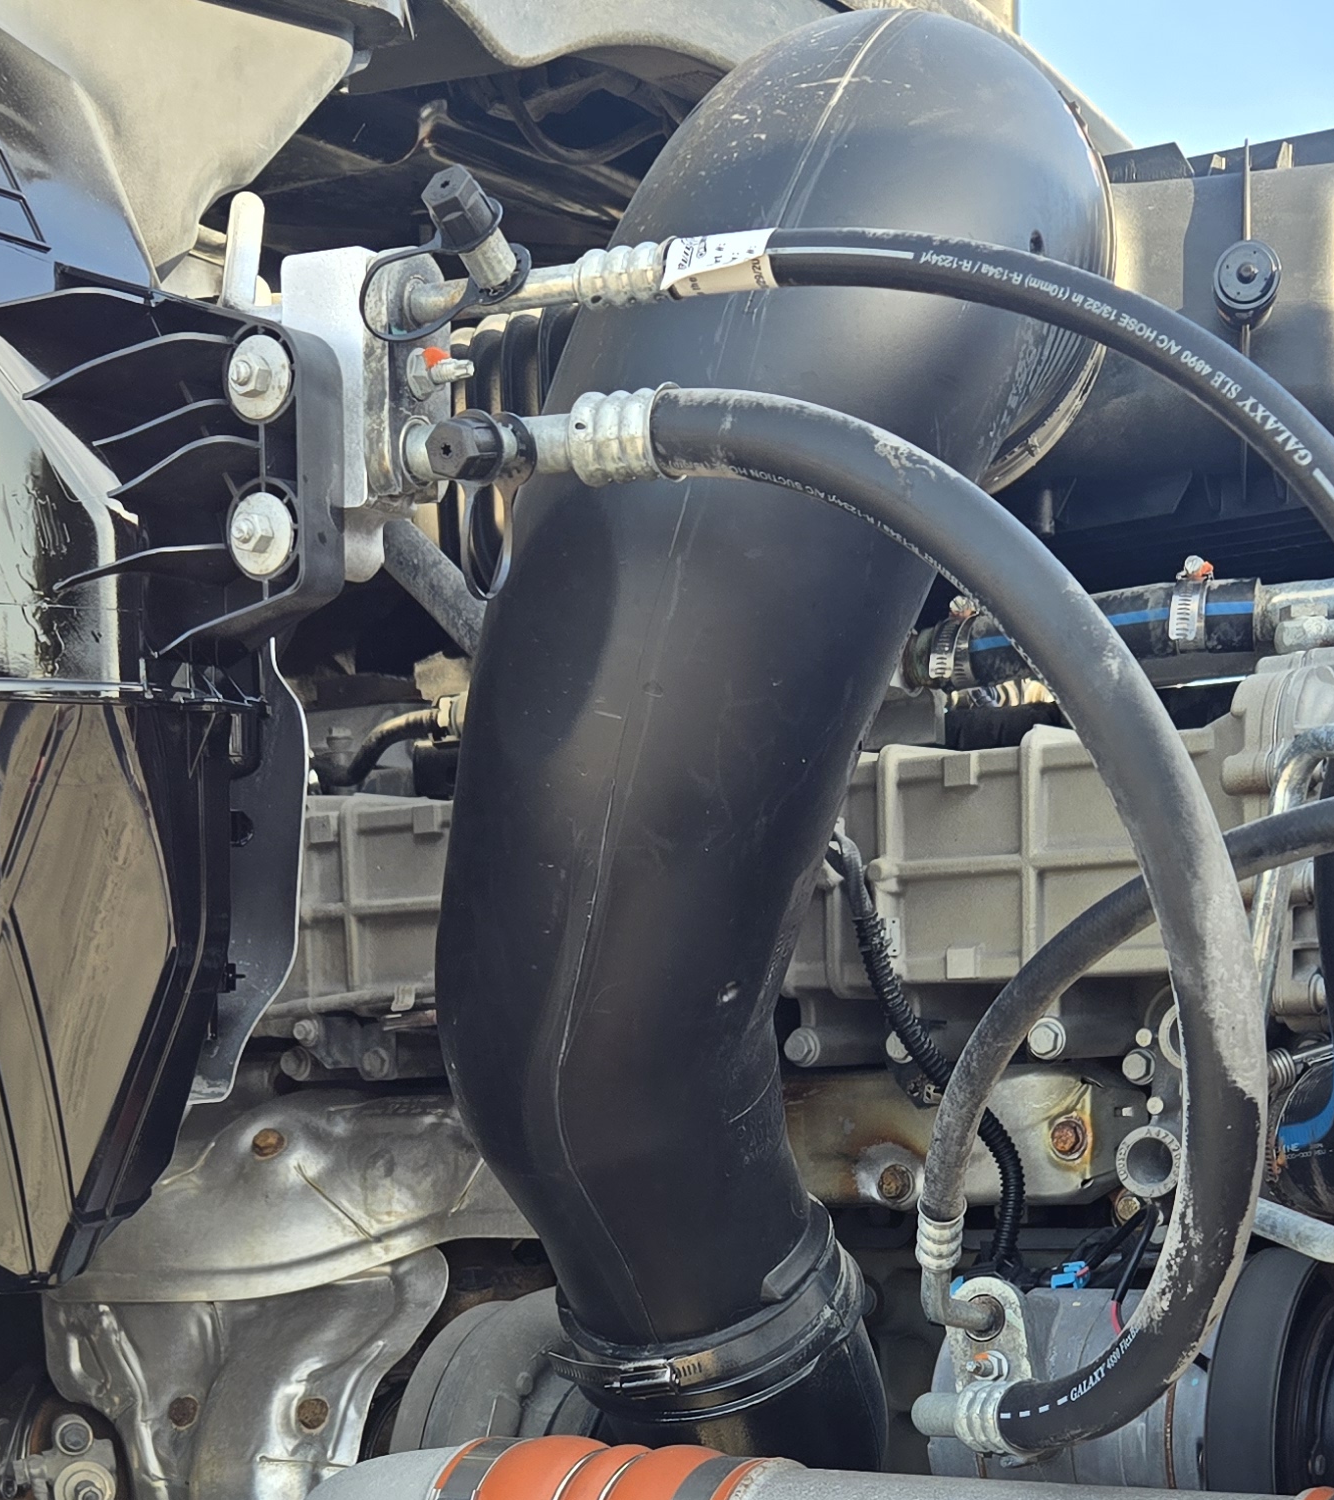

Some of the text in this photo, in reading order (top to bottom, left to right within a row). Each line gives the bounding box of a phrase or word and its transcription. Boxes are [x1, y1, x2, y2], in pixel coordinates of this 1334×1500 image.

[919, 250, 972, 272] R-1234yf
[981, 264, 1023, 286] R-134a
[1024, 273, 1071, 300] (10mm)
[1071, 292, 1085, 307] in
[1084, 297, 1118, 321] 13/32
[1117, 312, 1158, 343] HOSE
[1155, 335, 1182, 355] A/C
[1180, 350, 1213, 377] 4890
[1236, 395, 1313, 467] GALAXY
[749, 468, 804, 491] SUCTION
[1069, 1362, 1107, 1402] GALAXY
